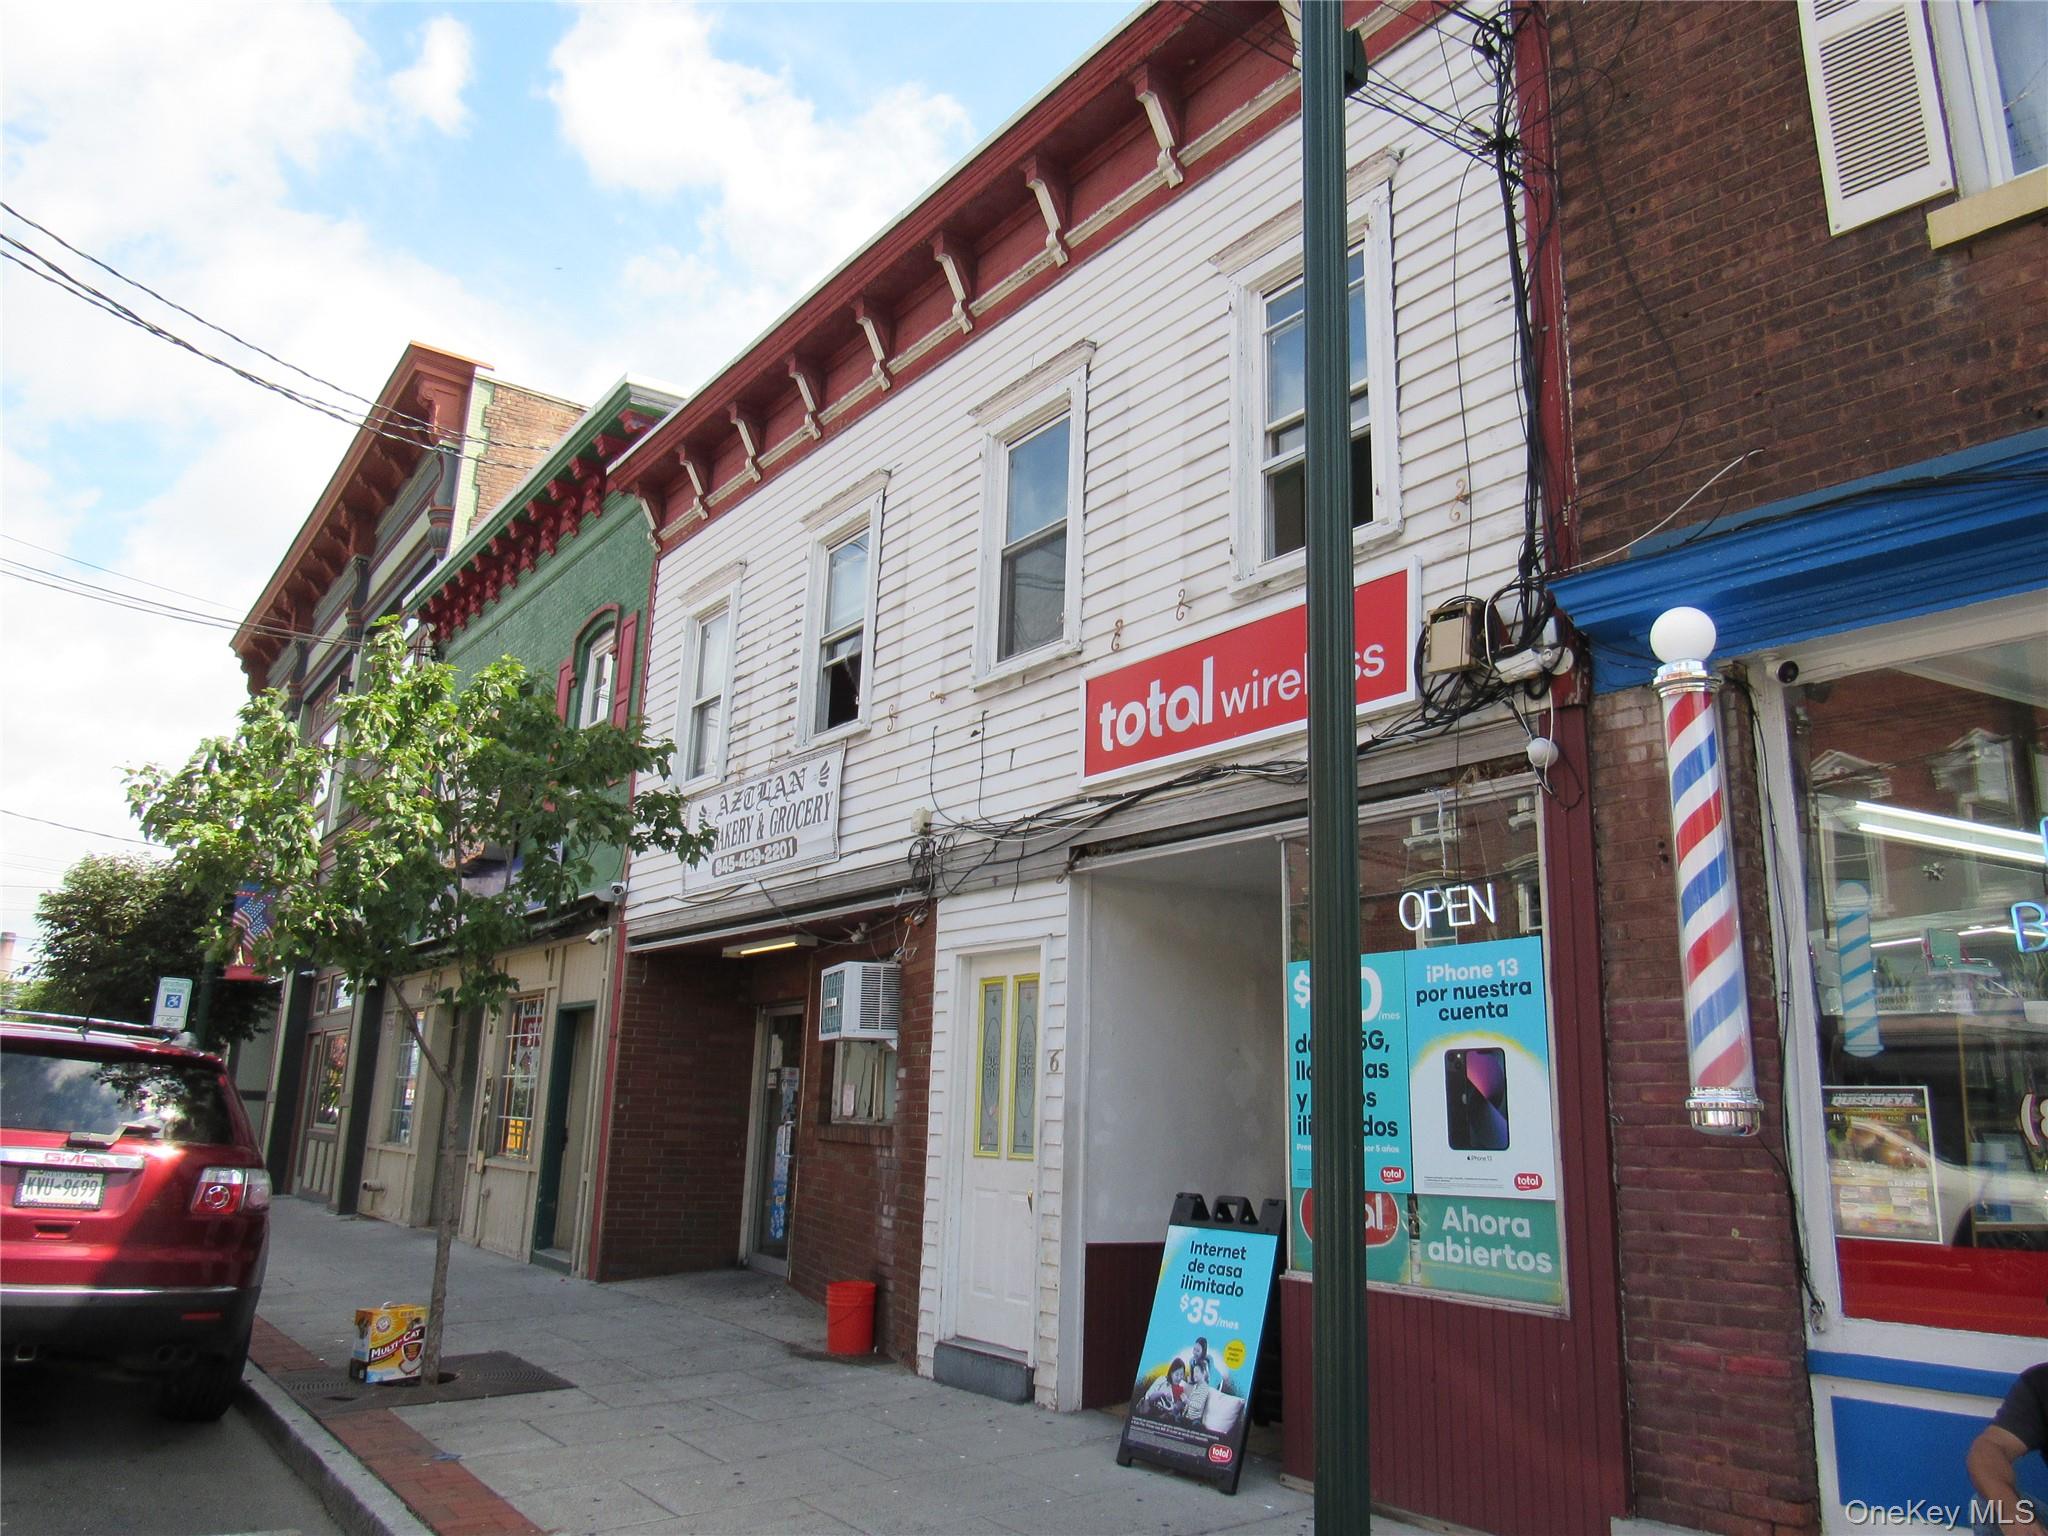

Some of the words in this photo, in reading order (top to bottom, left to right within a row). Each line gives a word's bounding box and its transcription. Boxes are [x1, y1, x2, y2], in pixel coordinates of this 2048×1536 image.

[1100, 656, 1213, 751] total
[1221, 644, 1385, 718] wirels
[715, 766, 807, 824] AZTLAN
[757, 812, 765, 840] &
[770, 791, 834, 837] GROCERY
[714, 838, 794, 876] 845-429-2201
[1399, 882, 1496, 931] OPEN
[1426, 964, 1494, 983] iPhone
[1498, 958, 1520, 977] 13
[1416, 986, 1449, 1007] por
[1453, 980, 1532, 1000] nuestra
[1438, 1001, 1509, 1021] cuenta
[1383, 1168, 1402, 1179] total
[1517, 1175, 1539, 1186] total
[1442, 1206, 1531, 1239] Ahora
[1190, 1241, 1247, 1260] Internet
[1428, 1236, 1553, 1273] abiertos
[1188, 1258, 1205, 1273] de
[1208, 1265, 1243, 1278] casa
[1180, 1275, 1244, 1297] ilimitado
[1212, 1447, 1229, 1459] total
